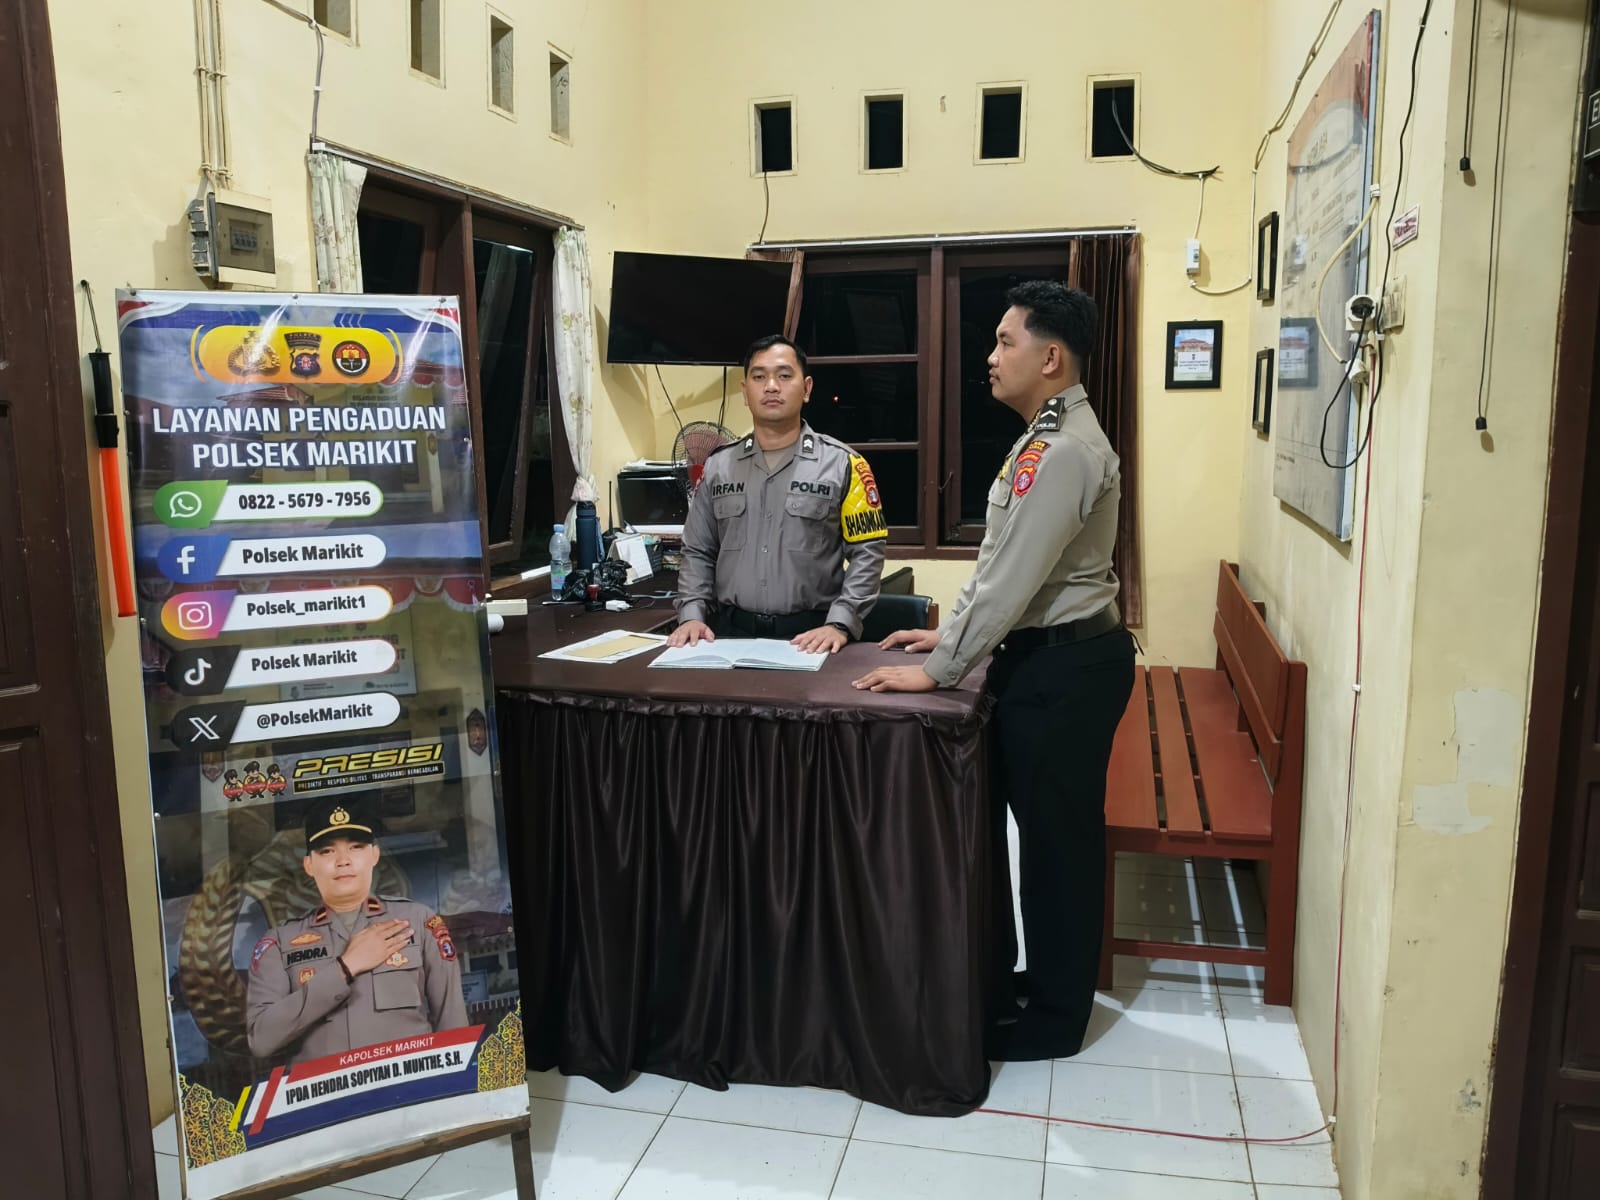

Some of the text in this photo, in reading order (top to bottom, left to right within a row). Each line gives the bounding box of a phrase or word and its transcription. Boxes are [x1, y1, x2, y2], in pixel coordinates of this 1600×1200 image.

[152, 406, 446, 433] LAYANAN PENGADUAN
[192, 440, 417, 468] POLSEK MARIKIT
[712, 482, 745, 496] IRFAN
[790, 480, 831, 496] POLRI
[238, 494, 275, 510] 0822
[287, 492, 324, 509] 5679
[335, 491, 371, 507] 7956
[242, 542, 364, 564] Polsek Marikit
[246, 595, 366, 616] Polsek_marikit1
[251, 649, 358, 671] Polsek Marikit
[257, 703, 373, 729] @PolsekMarikit
[294, 744, 443, 778] PRESISI
[286, 946, 328, 966] HENDRA
[339, 1036, 434, 1066] KAPOLSEK MARIKIT
[286, 1050, 464, 1106] IPDA HENDRA SOPIYAN D. MUNTHE, S.H.
